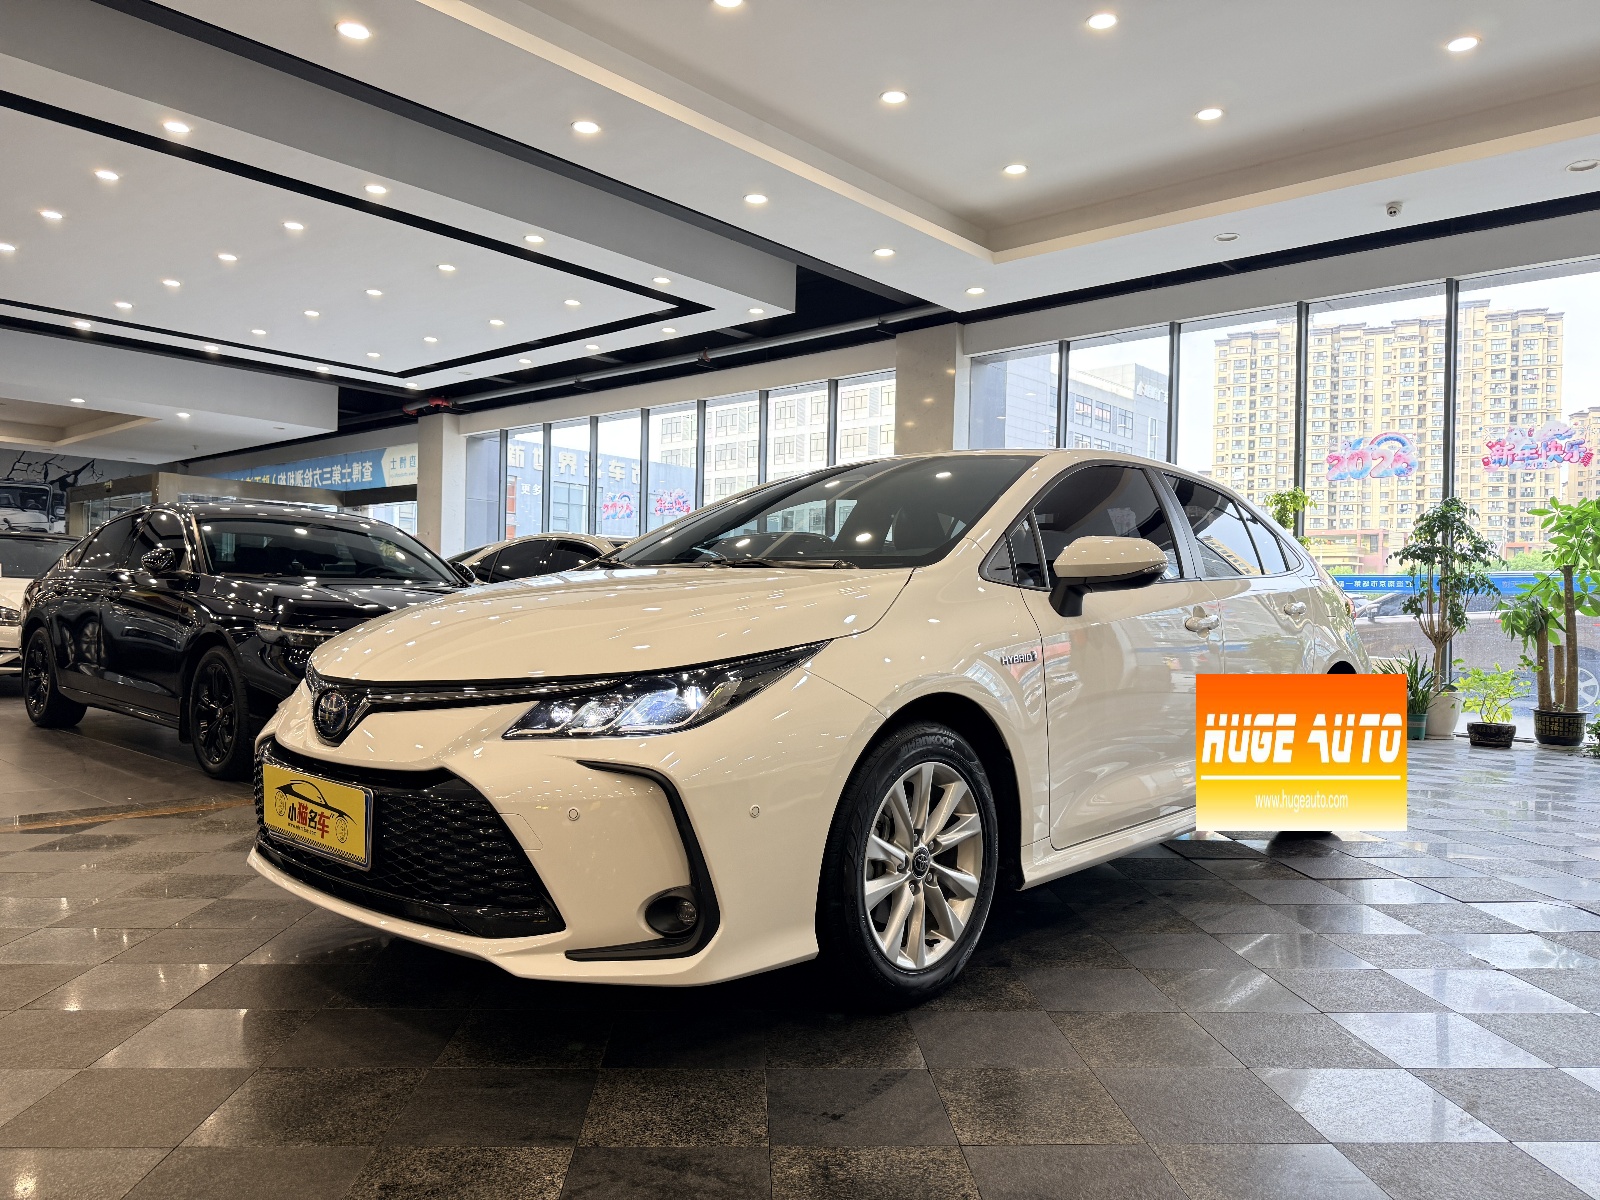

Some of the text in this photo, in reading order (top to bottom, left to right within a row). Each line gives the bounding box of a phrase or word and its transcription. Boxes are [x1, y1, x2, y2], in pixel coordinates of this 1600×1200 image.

[1489, 439, 1587, 464] 新年快乐
[1326, 450, 1418, 482] 2026
[1001, 652, 1033, 666] HYBRID
